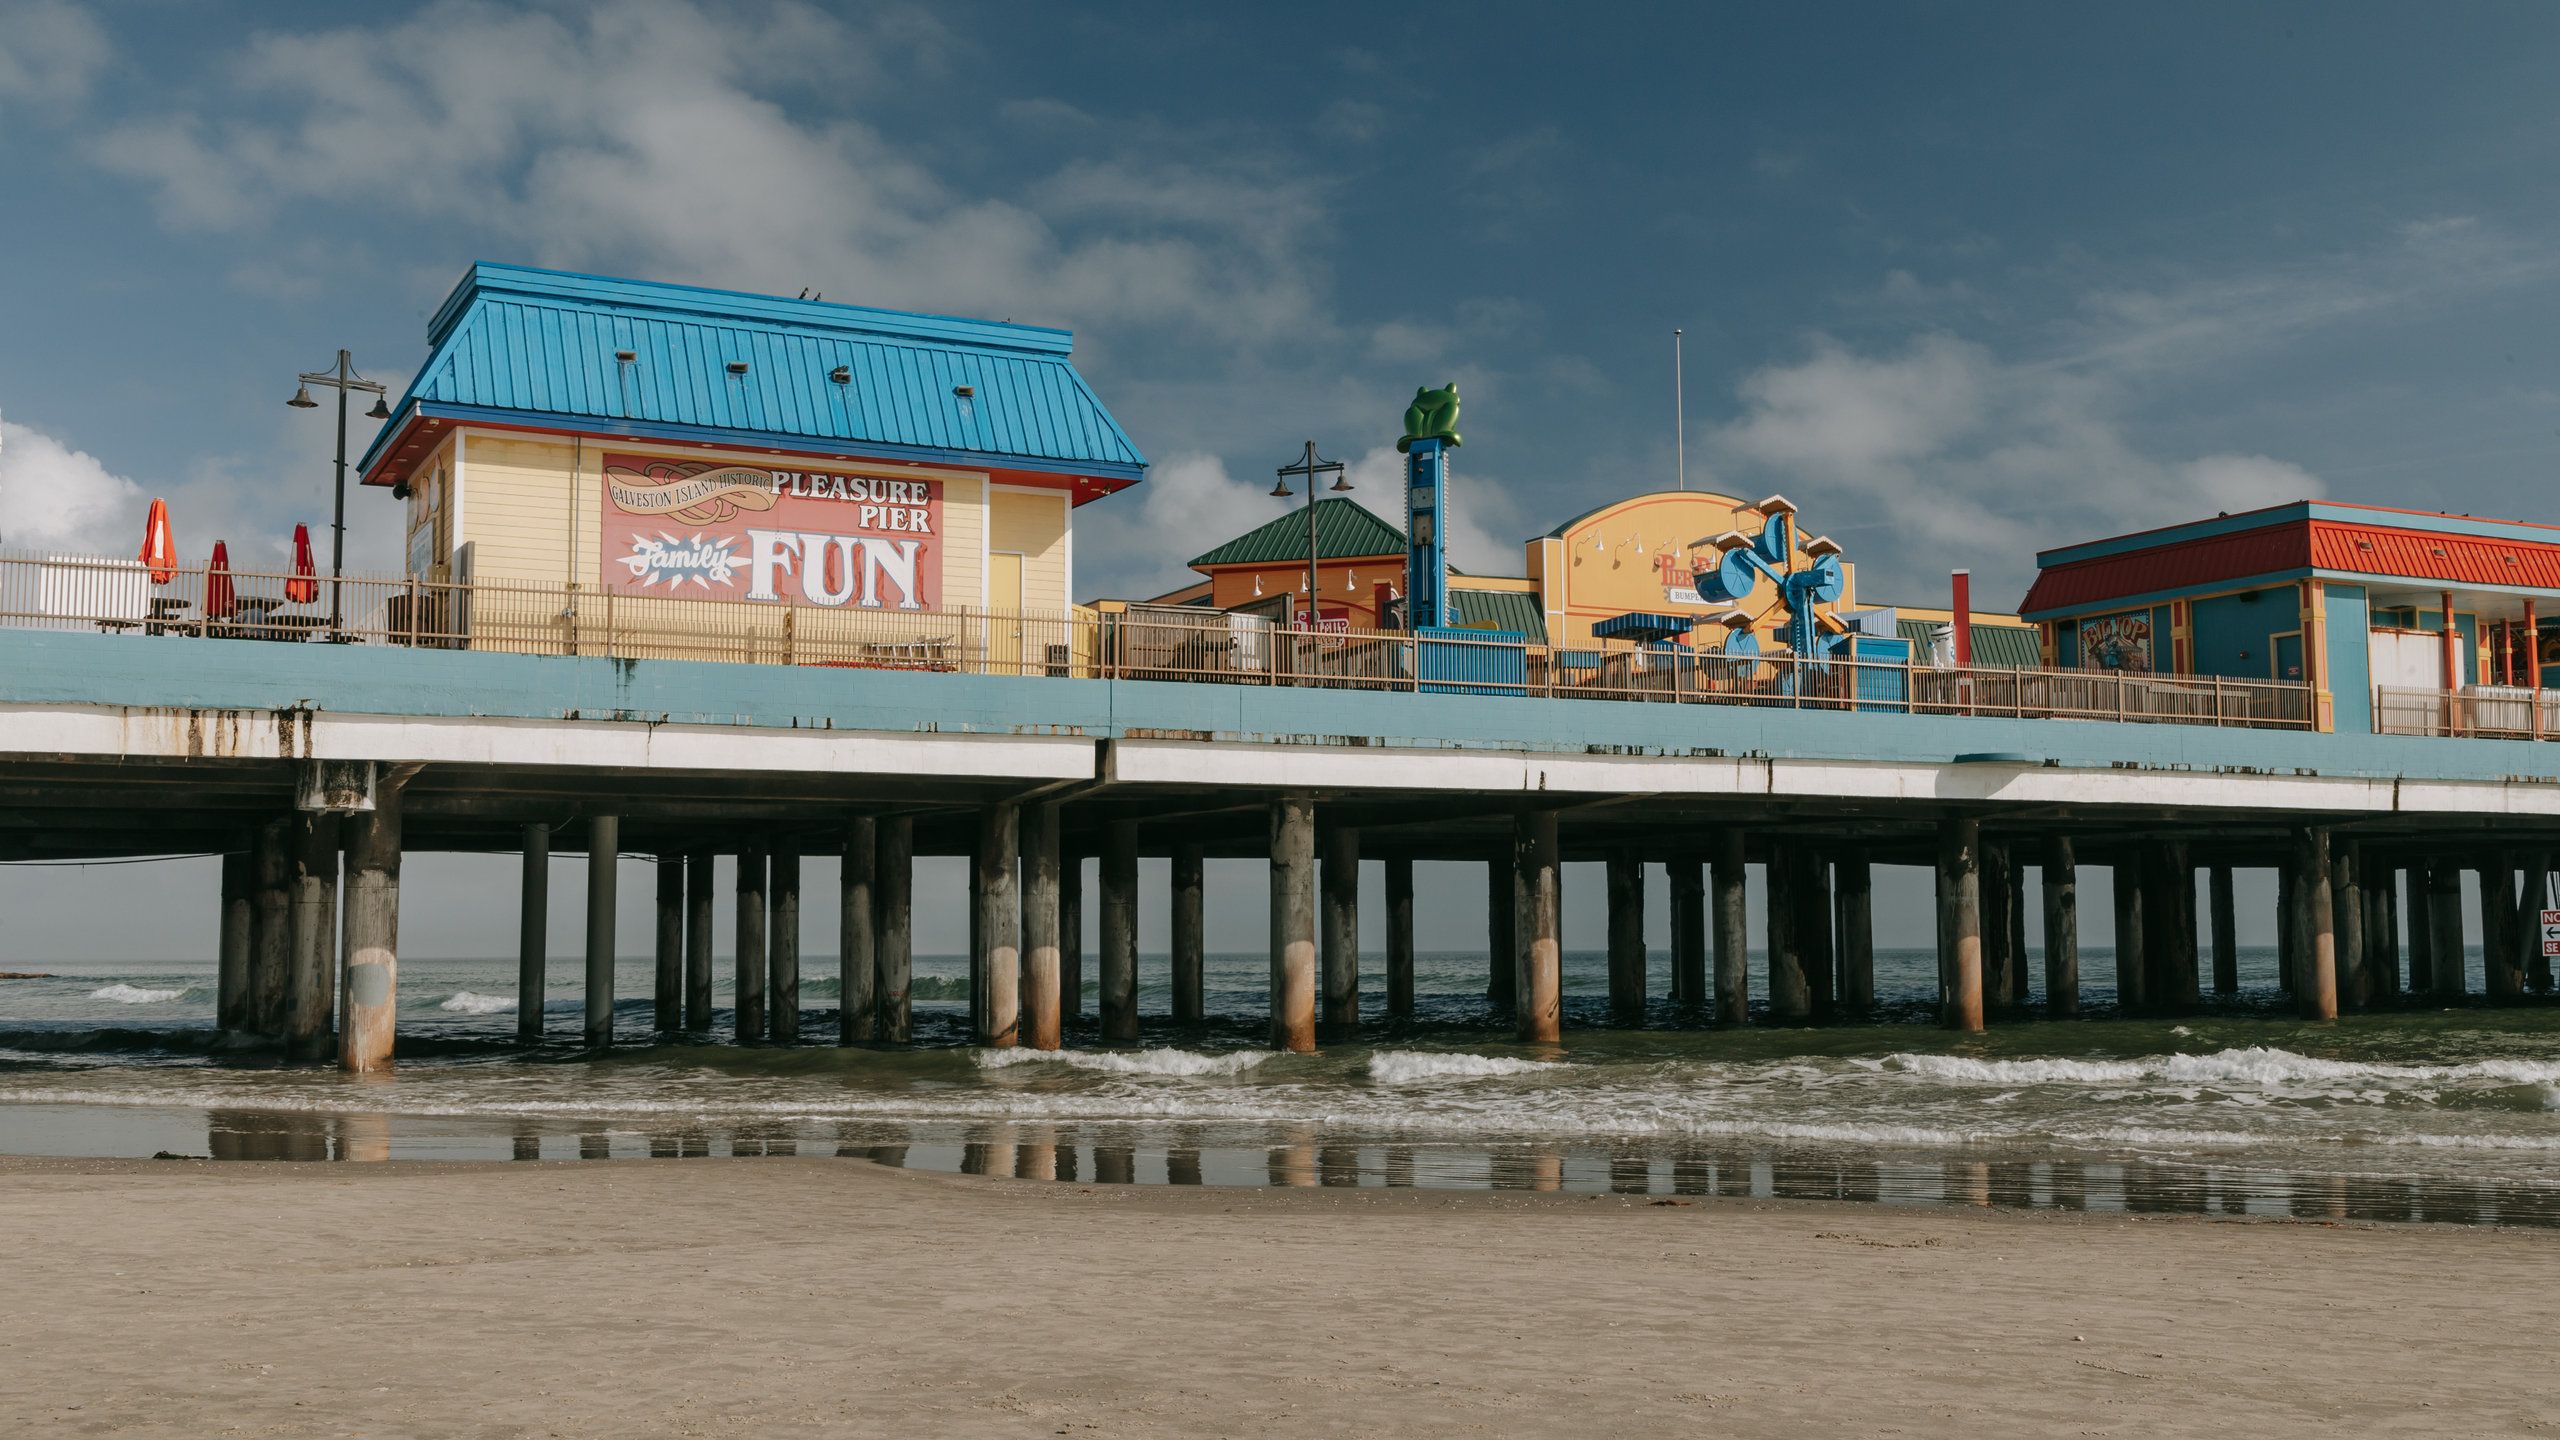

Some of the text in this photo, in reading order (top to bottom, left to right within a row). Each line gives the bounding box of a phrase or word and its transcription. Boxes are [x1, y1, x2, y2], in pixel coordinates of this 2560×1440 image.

[612, 472, 770, 508] GALVESTON ISLAND HISTORIC
[770, 470, 930, 506] PLEASURE
[858, 504, 933, 534] PIER
[628, 538, 732, 580] Family
[745, 528, 922, 610] FUN
[1675, 591, 1703, 602] BUMPE
[2115, 616, 2147, 640] TOP
